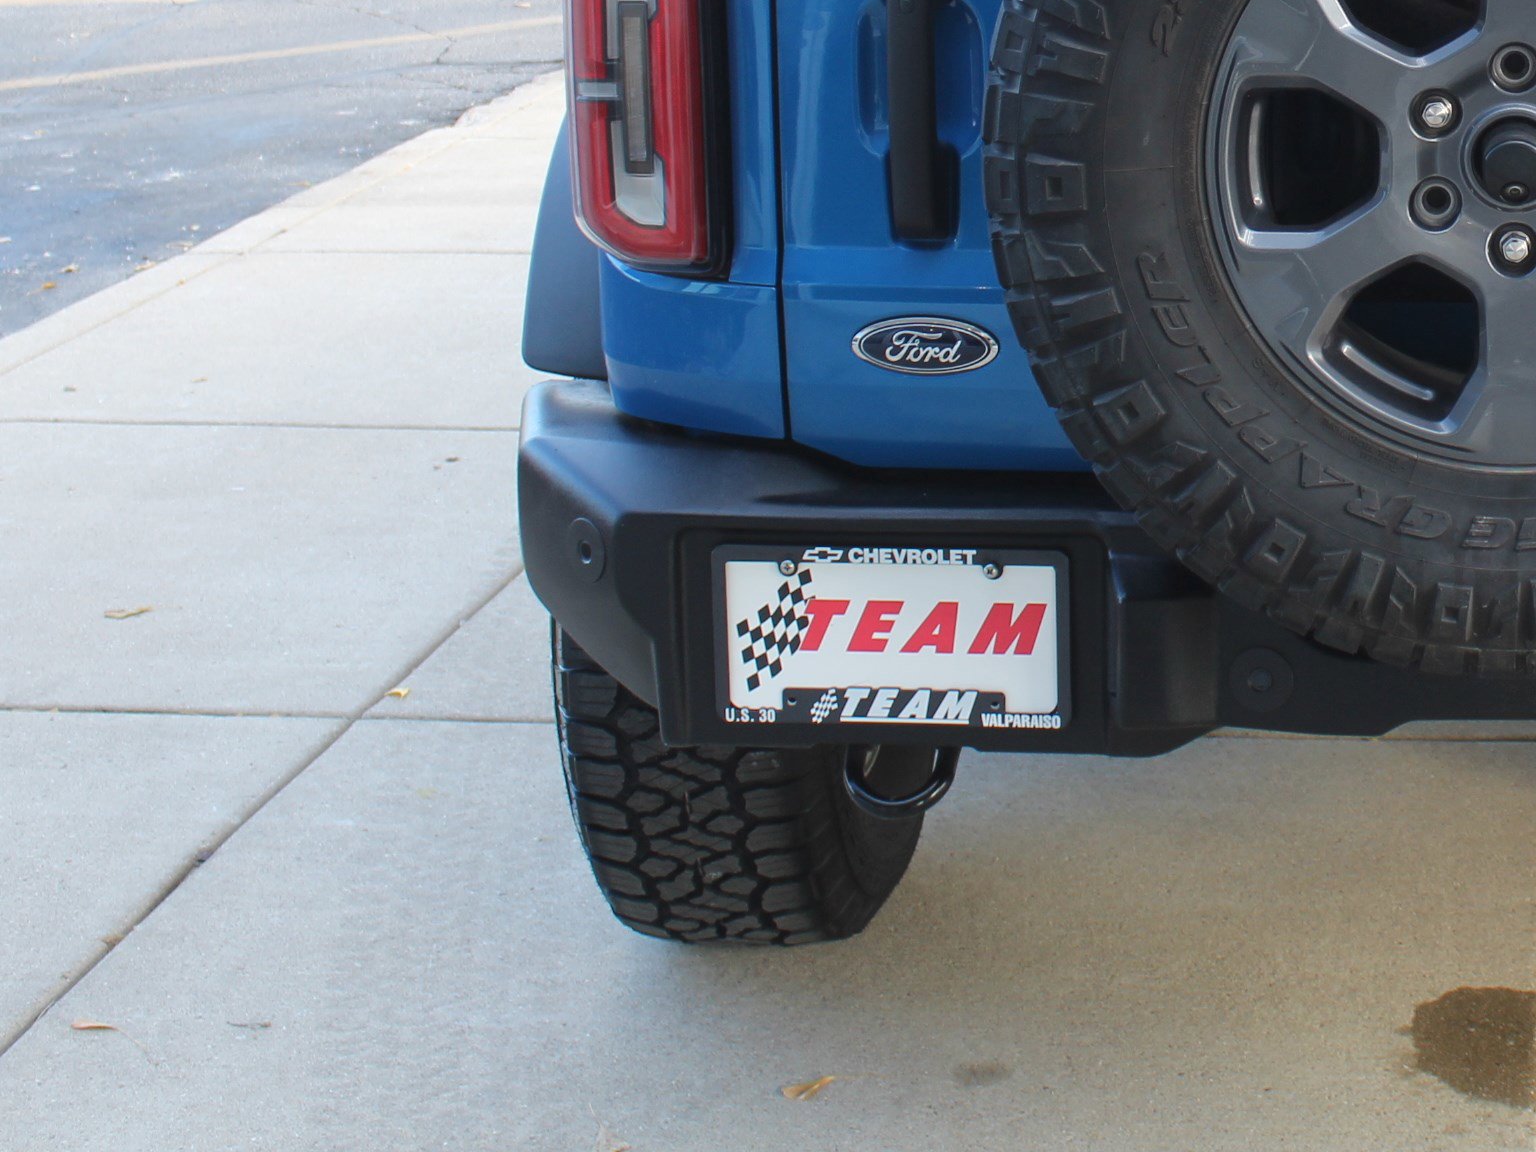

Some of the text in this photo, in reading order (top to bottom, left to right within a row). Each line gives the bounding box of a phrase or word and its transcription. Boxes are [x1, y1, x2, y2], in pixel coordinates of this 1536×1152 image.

[885, 330, 962, 364] Ford
[1136, 251, 1453, 540] GRAPPLER
[848, 548, 976, 565] CHEVROLET
[799, 599, 1047, 655] TEAM
[725, 708, 1061, 729] U.S. 30 VALPARAISO
[840, 688, 977, 720] TEAM
